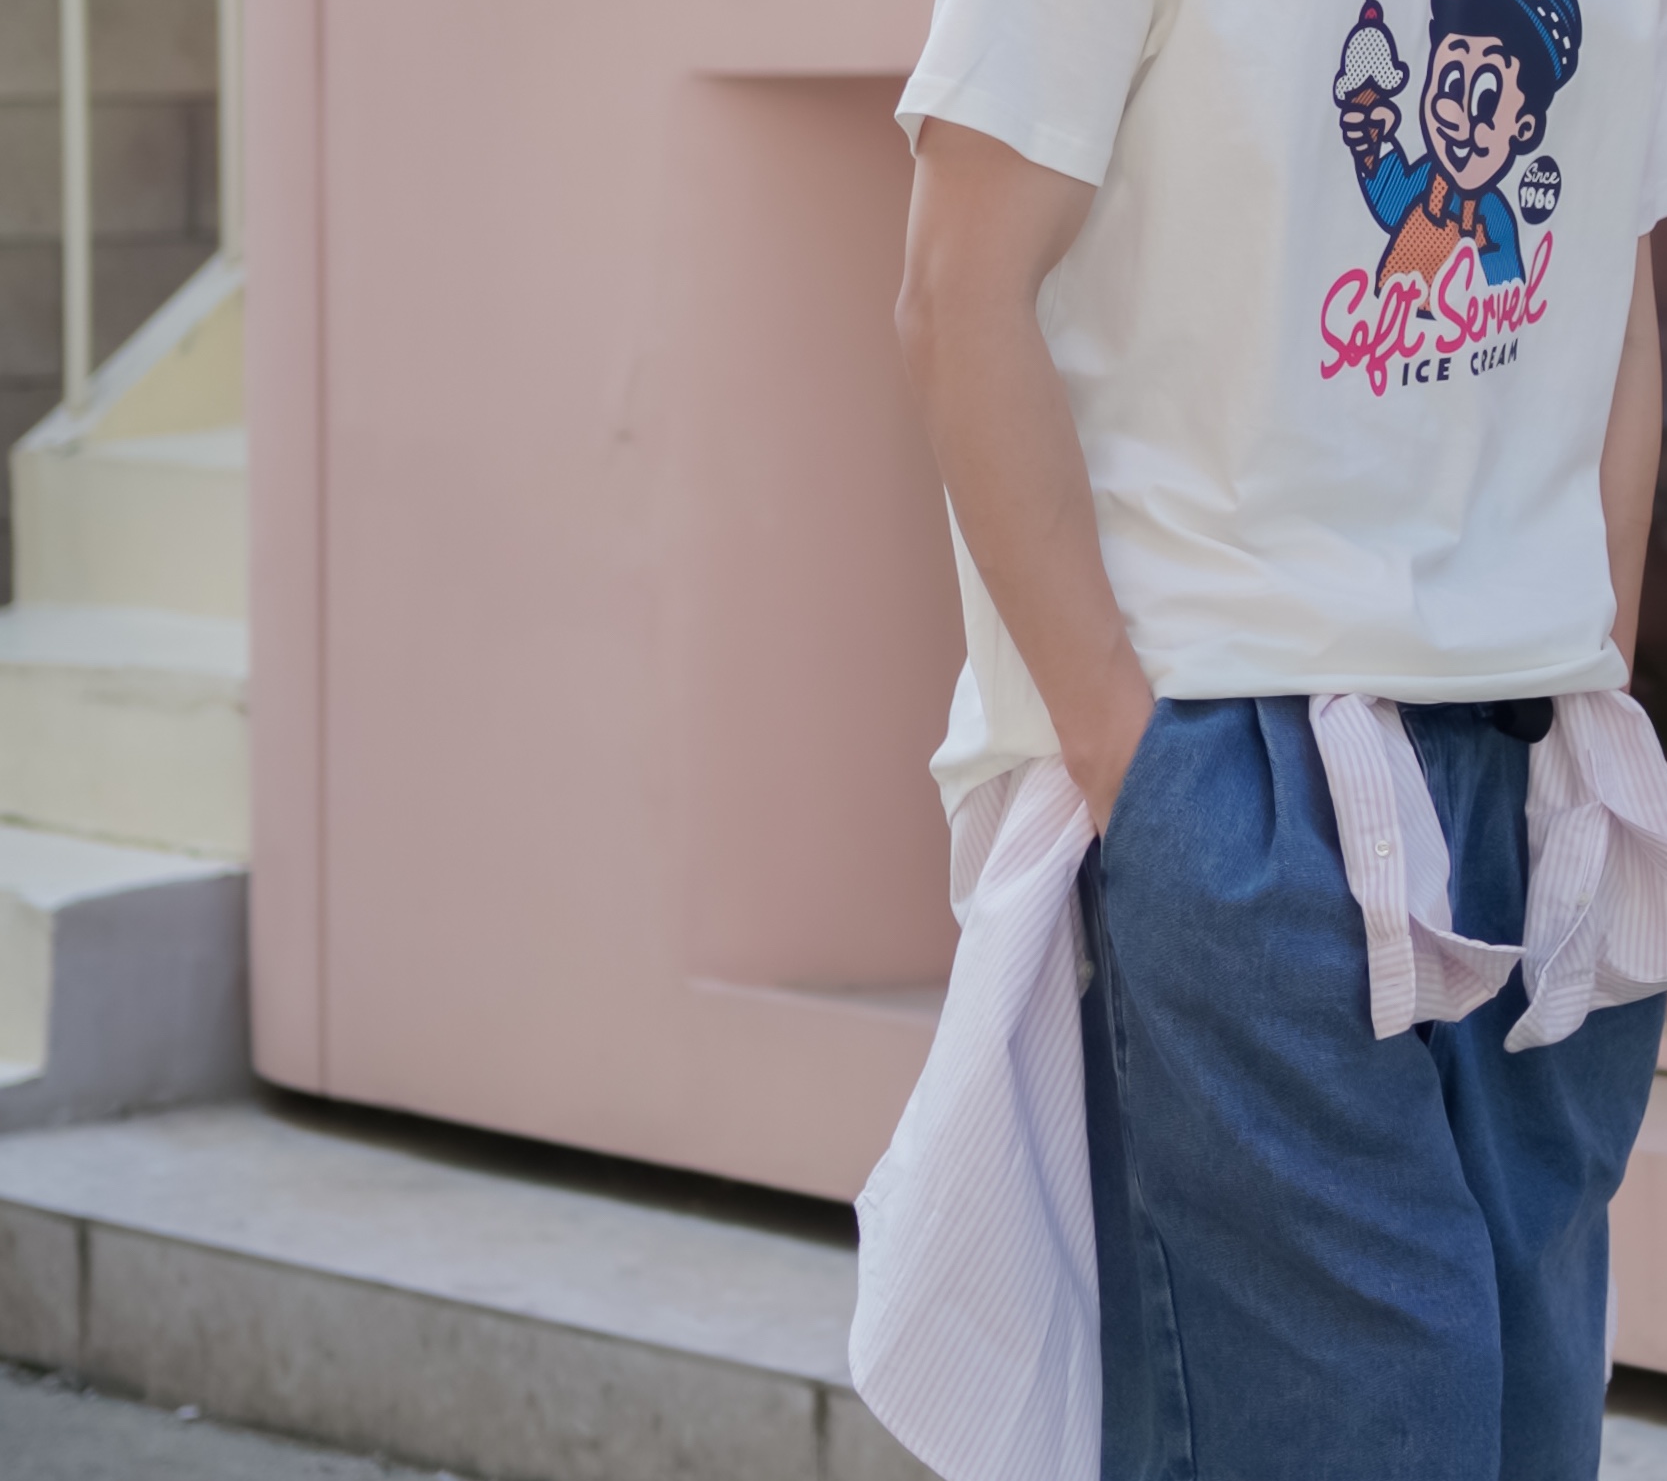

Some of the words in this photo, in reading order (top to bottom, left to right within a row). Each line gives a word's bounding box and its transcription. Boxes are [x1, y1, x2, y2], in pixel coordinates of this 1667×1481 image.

[1524, 162, 1560, 184] Since
[1520, 186, 1555, 210] 1966
[1320, 268, 1425, 397] Soft
[1435, 231, 1553, 353] Served
[1402, 357, 1451, 386] ICE
[1470, 338, 1518, 376] CREAM
